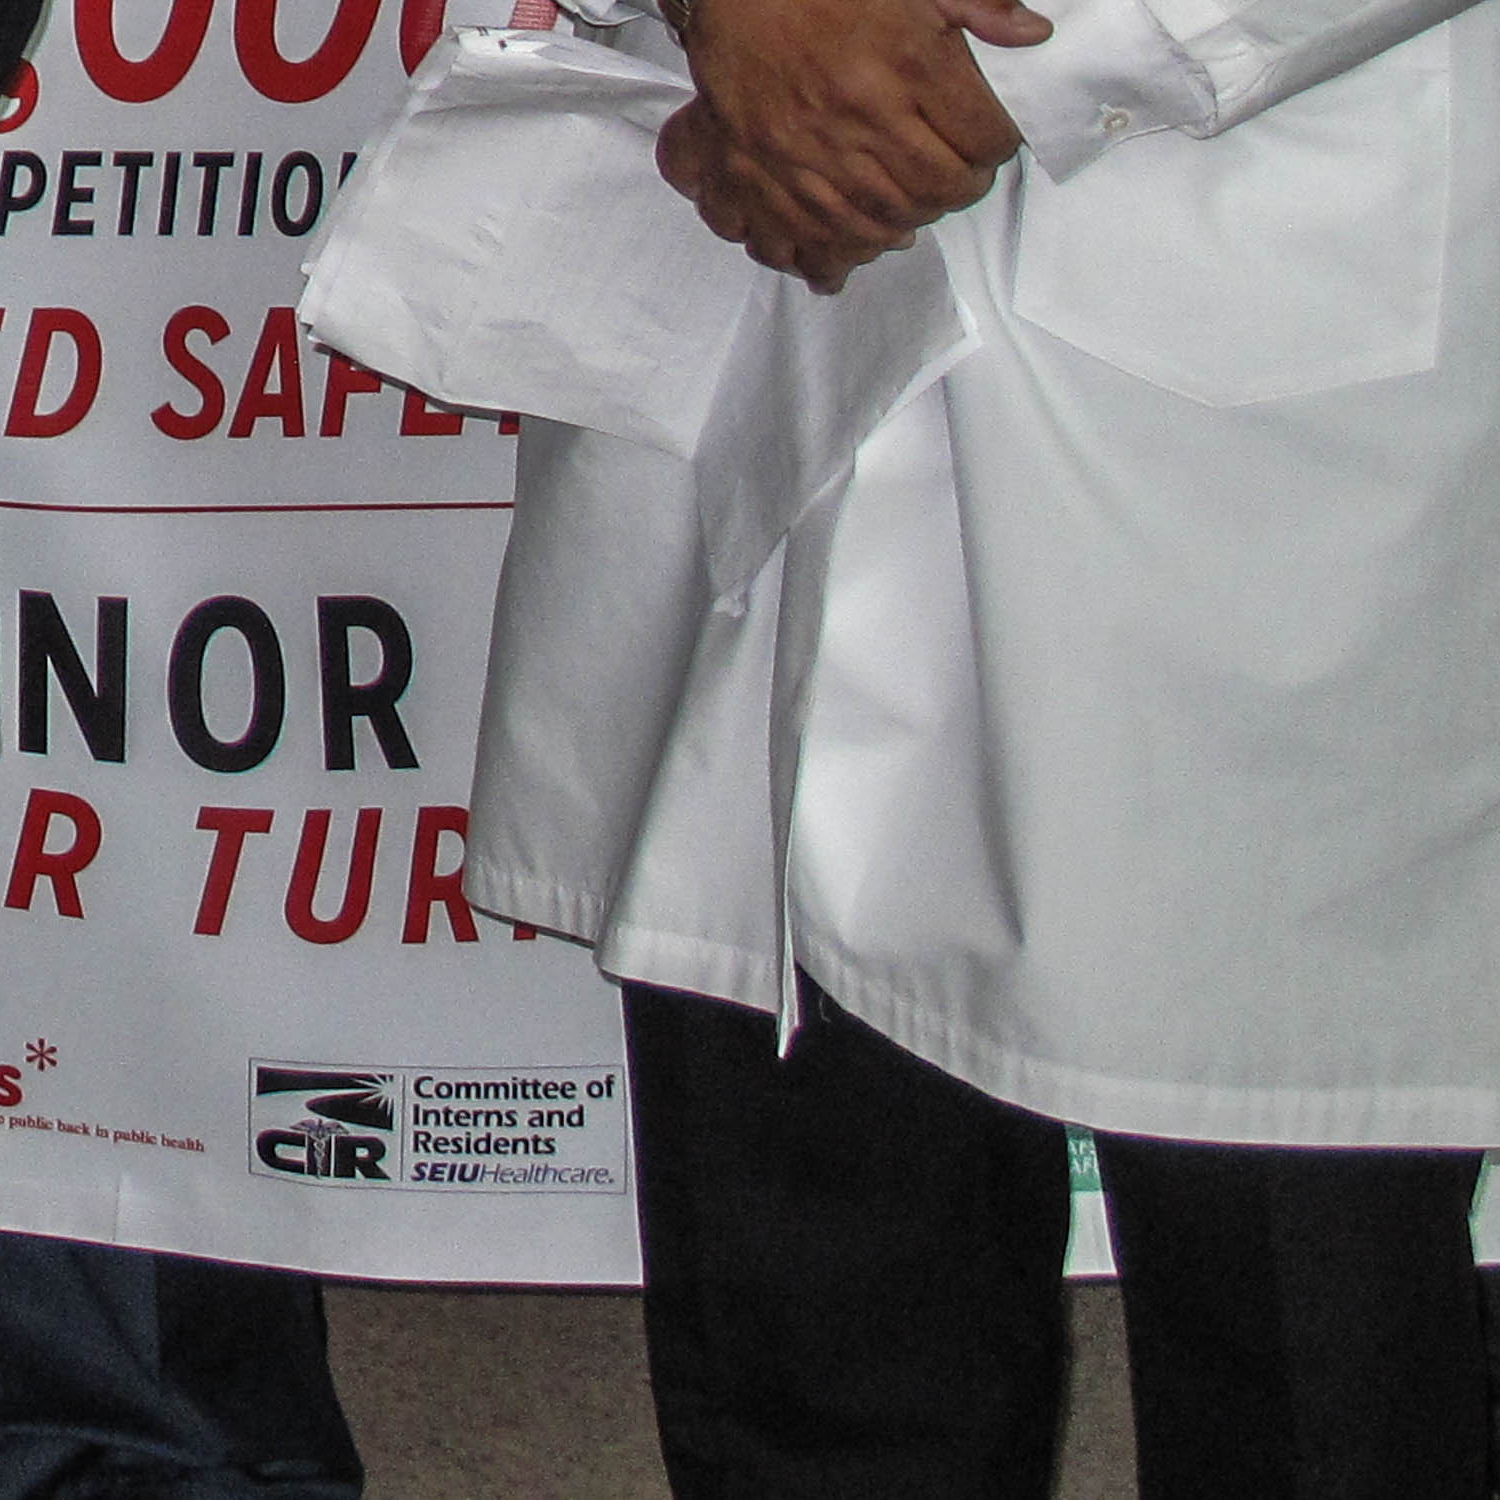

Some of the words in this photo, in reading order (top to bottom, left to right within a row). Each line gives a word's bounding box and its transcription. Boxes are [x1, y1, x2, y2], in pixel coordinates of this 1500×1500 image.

[18, 587, 421, 774] NOR
[192, 805, 537, 945] TUR
[413, 1074, 577, 1100] Committee
[586, 1073, 615, 1098] of
[412, 1103, 517, 1128] Interns
[527, 1103, 585, 1128] and
[8, 1114, 54, 1132] public
[56, 1119, 90, 1136] back
[94, 1124, 109, 1138] in
[112, 1126, 157, 1146] public
[160, 1132, 205, 1153] health
[412, 1130, 557, 1156] Residents
